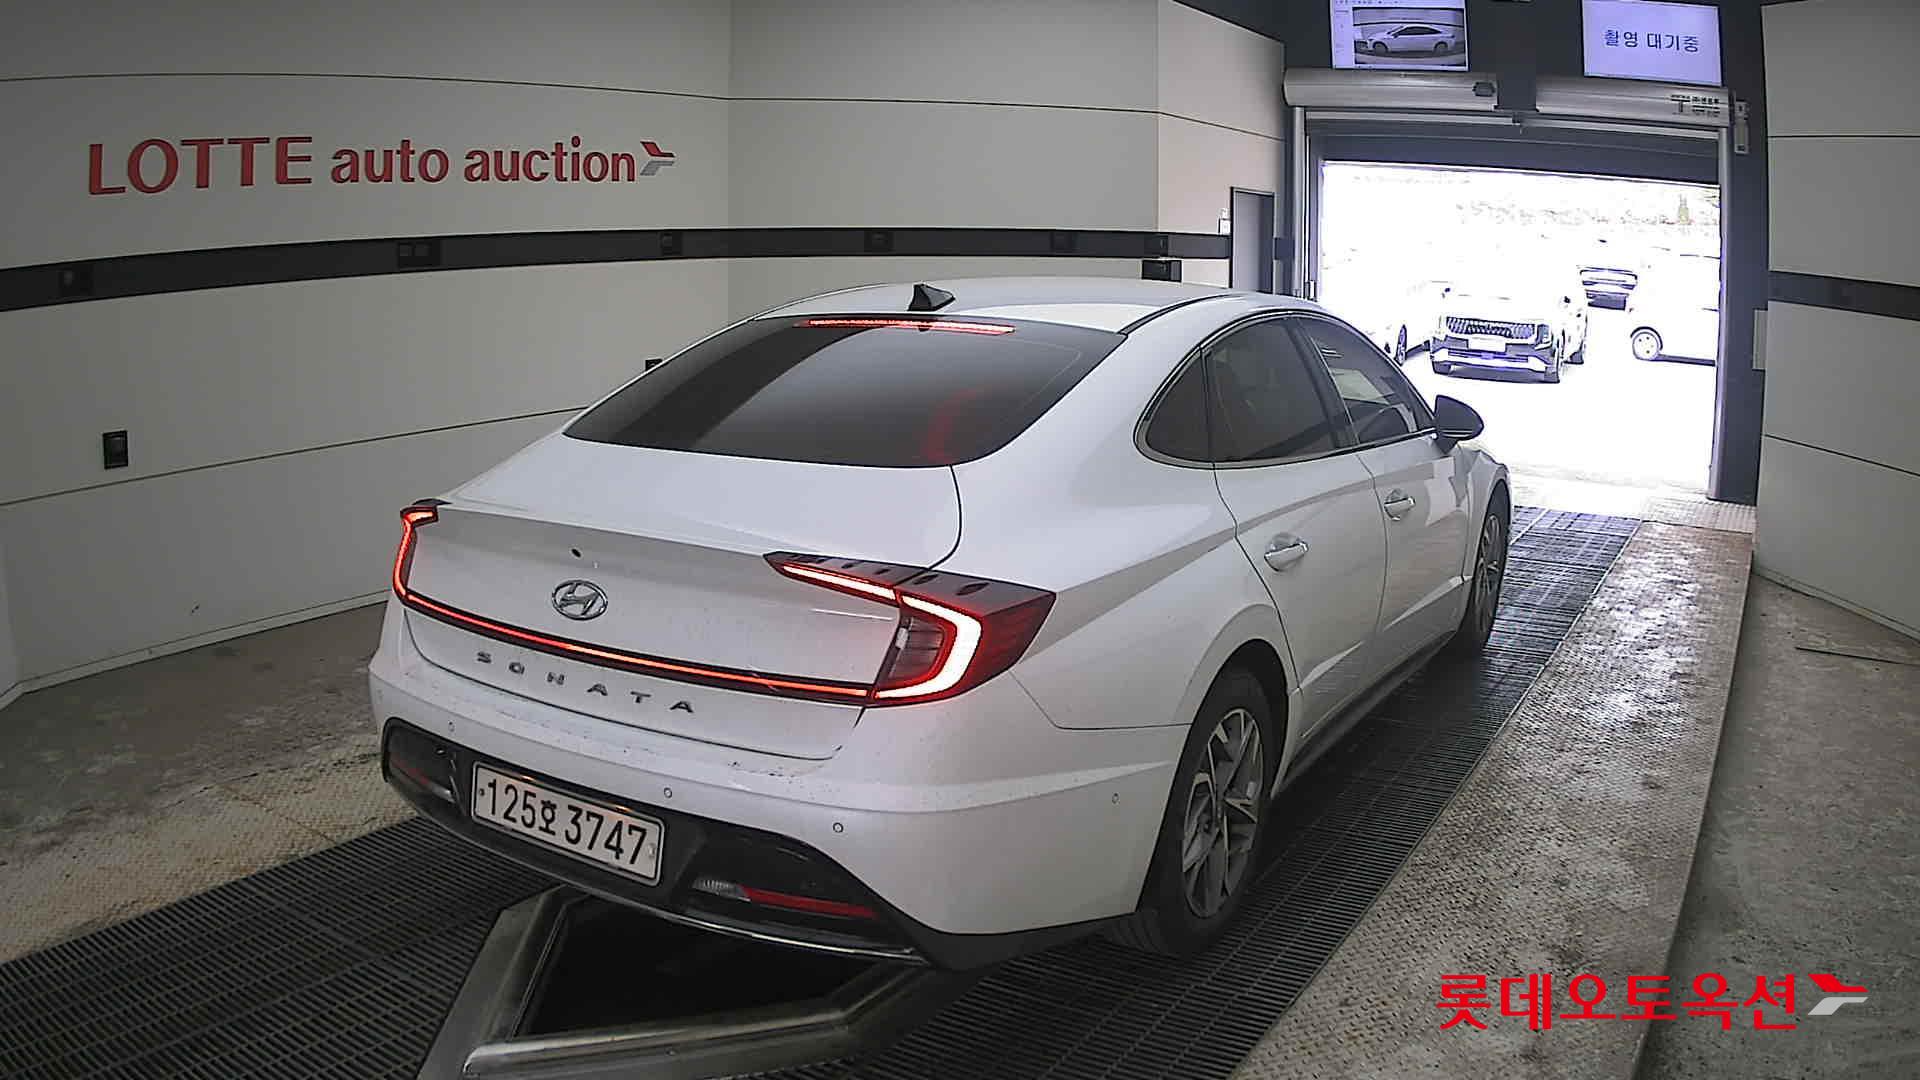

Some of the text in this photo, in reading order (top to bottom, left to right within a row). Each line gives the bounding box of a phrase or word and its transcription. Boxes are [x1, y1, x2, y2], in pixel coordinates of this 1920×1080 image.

[1647, 33, 1699, 53] 대기중
[88, 135, 637, 195] LOTTE auto auction
[476, 650, 694, 714] SONATA
[564, 804, 648, 865] 3747
